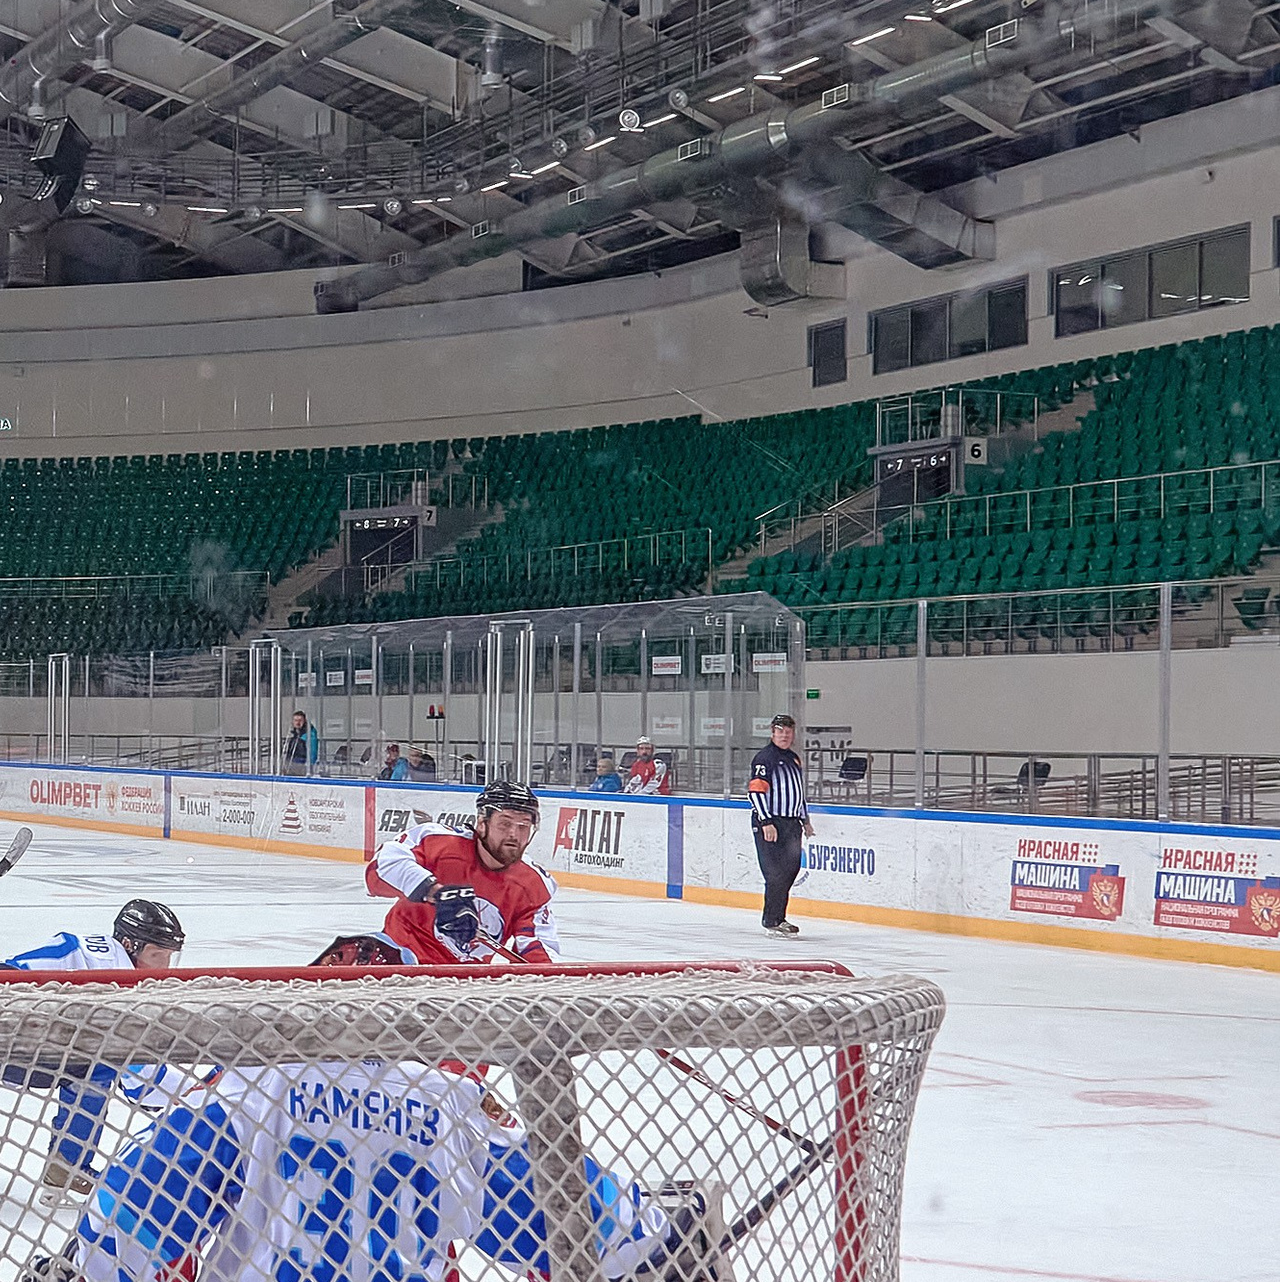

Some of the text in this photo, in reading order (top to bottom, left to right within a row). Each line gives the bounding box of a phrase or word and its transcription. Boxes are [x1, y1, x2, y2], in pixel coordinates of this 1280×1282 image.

[971, 444, 982, 458] 6
[896, 456, 937, 470] 7 6
[393, 518, 400, 528] 7
[426, 510, 433, 521] 7
[754, 764, 767, 776] 73
[30, 779, 102, 808] OLIMPBET
[222, 809, 255, 825] 2-000-007
[574, 808, 625, 855] АГАТ
[573, 852, 625, 869] АВТОХОЛДИНГ
[808, 843, 876, 876] БУРЭНЕРГО
[1017, 839, 1080, 862] КРАСНАЯ
[1163, 848, 1236, 873] КРАСНАЯ
[1014, 863, 1080, 890] МАШИНА
[1159, 874, 1236, 904] МАШИНА
